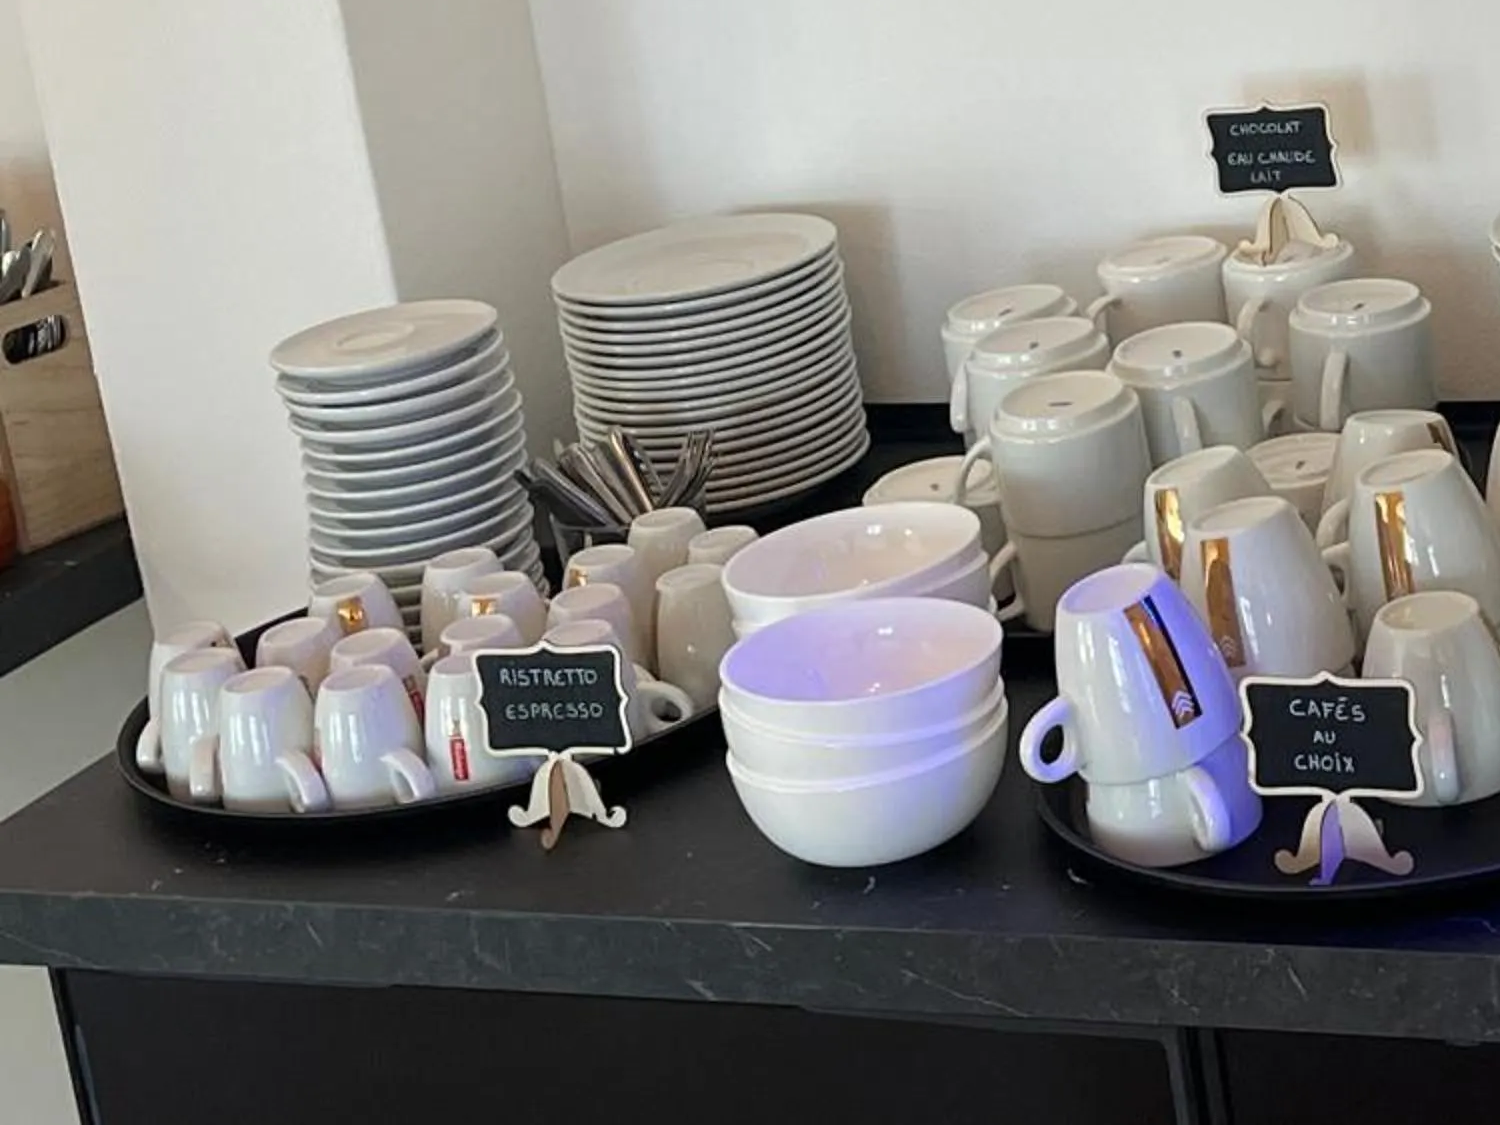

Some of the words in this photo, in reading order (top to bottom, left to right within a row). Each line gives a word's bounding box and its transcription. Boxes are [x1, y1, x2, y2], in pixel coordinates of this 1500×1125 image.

[1229, 121, 1301, 136] CHOCOLAT
[1227, 152, 1253, 166] EAU
[1257, 150, 1316, 164] CHAUDE
[1251, 170, 1281, 184] LAIT
[499, 667, 598, 687] RISTRETTO
[505, 702, 604, 721] ESPRESSO
[1288, 696, 1366, 722] CAFÉS
[1312, 730, 1337, 745] AU
[1293, 752, 1355, 773] CHOIX
